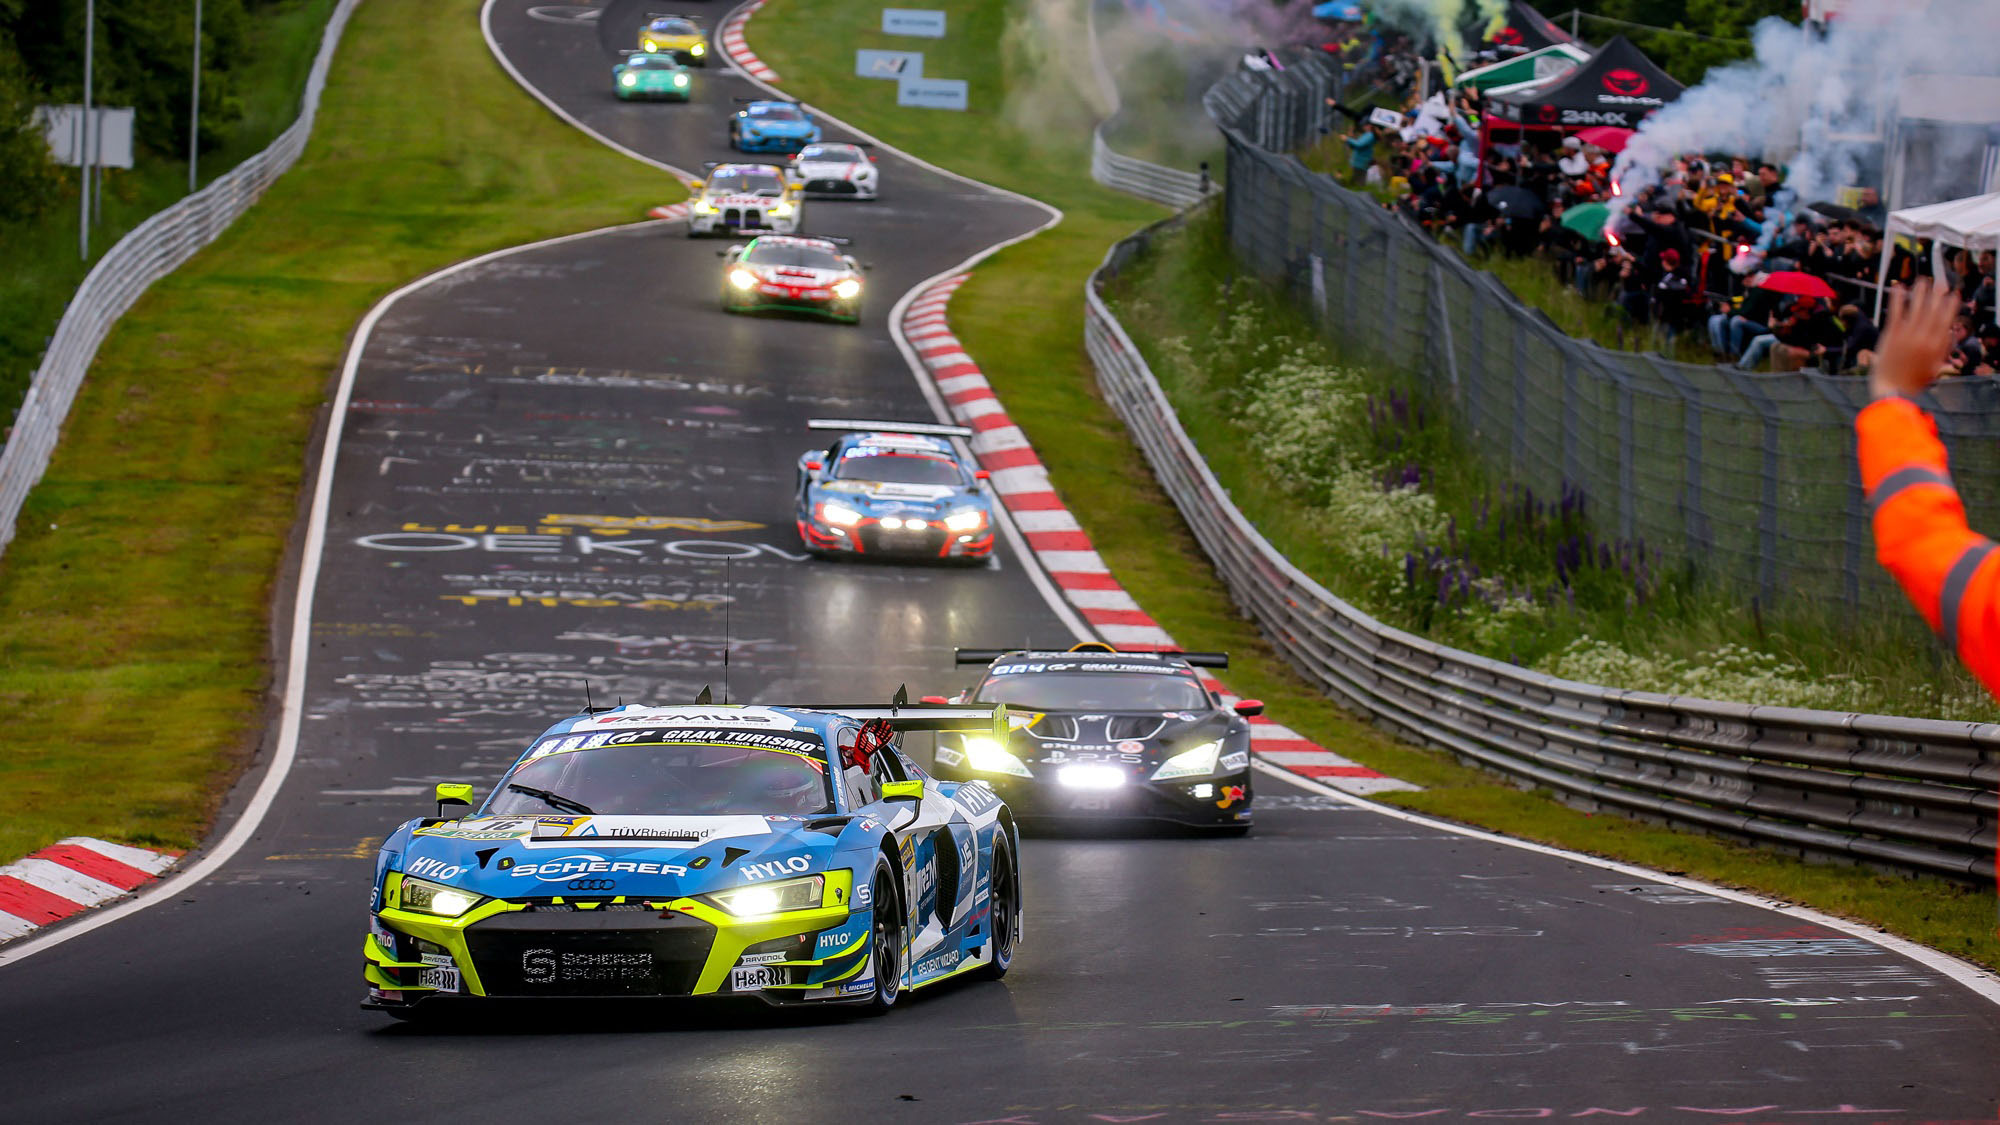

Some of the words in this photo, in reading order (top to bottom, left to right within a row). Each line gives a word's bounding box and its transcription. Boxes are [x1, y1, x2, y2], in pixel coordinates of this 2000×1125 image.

[1561, 109, 1628, 126] 24MX
[1081, 663, 1117, 672] GRAN
[616, 714, 771, 723] REMUS
[662, 730, 717, 740] GRAN
[727, 731, 816, 752] TURISMO
[752, 741, 810, 756] SIMULATOR
[480, 821, 523, 831] 16
[408, 855, 461, 880] HYLO
[510, 861, 688, 878] SCHERER
[739, 856, 809, 881] HYLO
[819, 932, 849, 948] HYLO
[423, 955, 450, 964] RAVENOL
[561, 952, 653, 966] SCHERER
[745, 954, 783, 963] RAVENOL
[420, 968, 441, 986] H&R
[735, 967, 767, 989] H&R
[848, 980, 874, 992] MICHELIN
